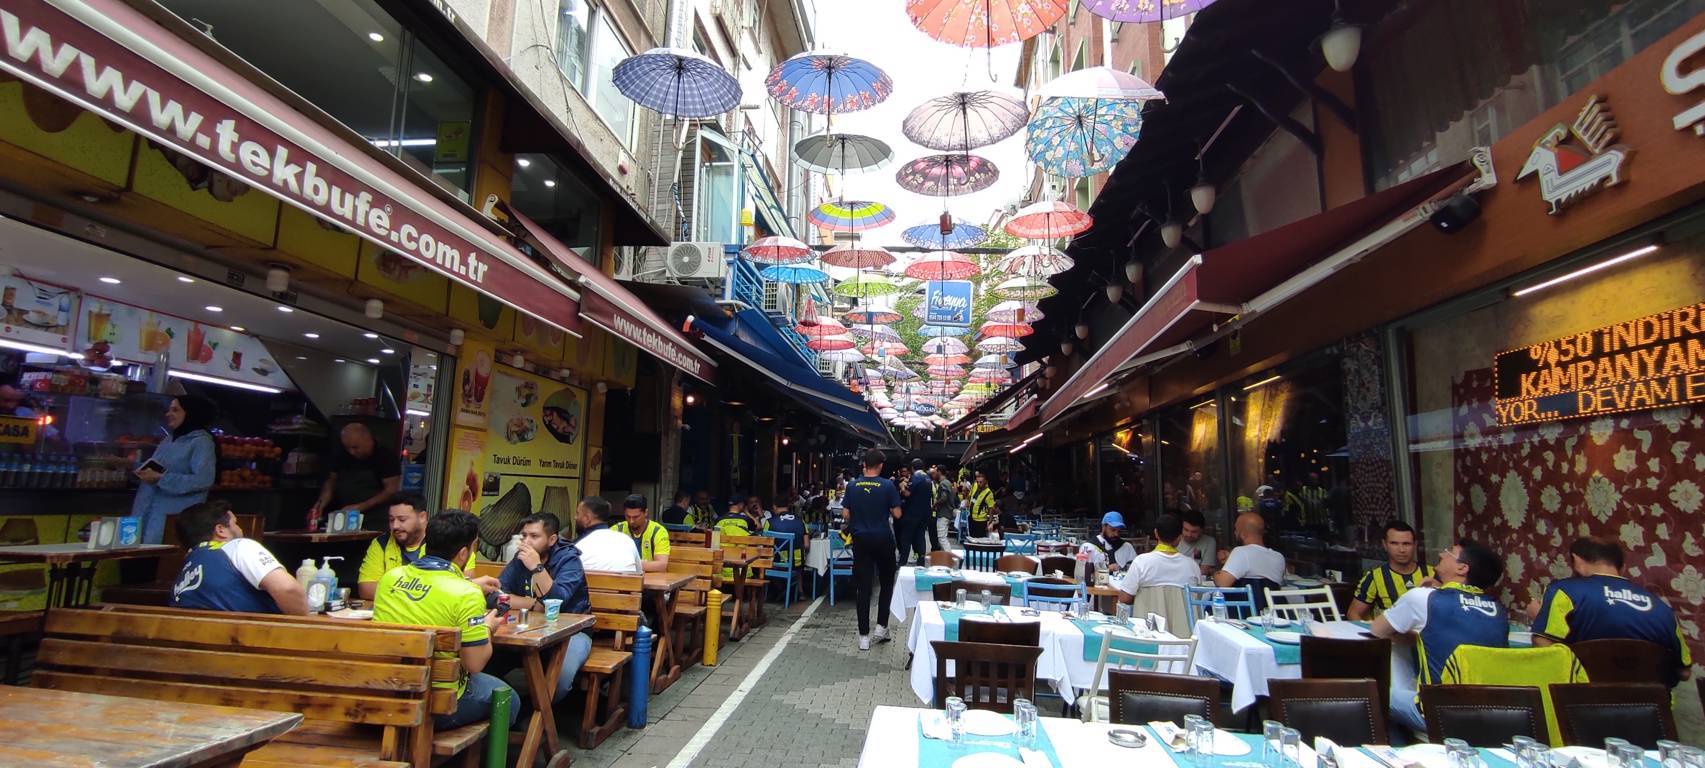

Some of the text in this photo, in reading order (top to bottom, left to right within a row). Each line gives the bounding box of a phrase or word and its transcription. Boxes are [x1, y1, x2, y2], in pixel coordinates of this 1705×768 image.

[613, 314, 701, 374] www.tekbufe.com.tr
[1530, 331, 1593, 367] %50
[1577, 376, 1677, 414] DEVAM
[493, 454, 511, 465] Tavuk
[392, 576, 432, 600] halley
[1603, 586, 1651, 608] halley
[1459, 594, 1497, 614] halley
